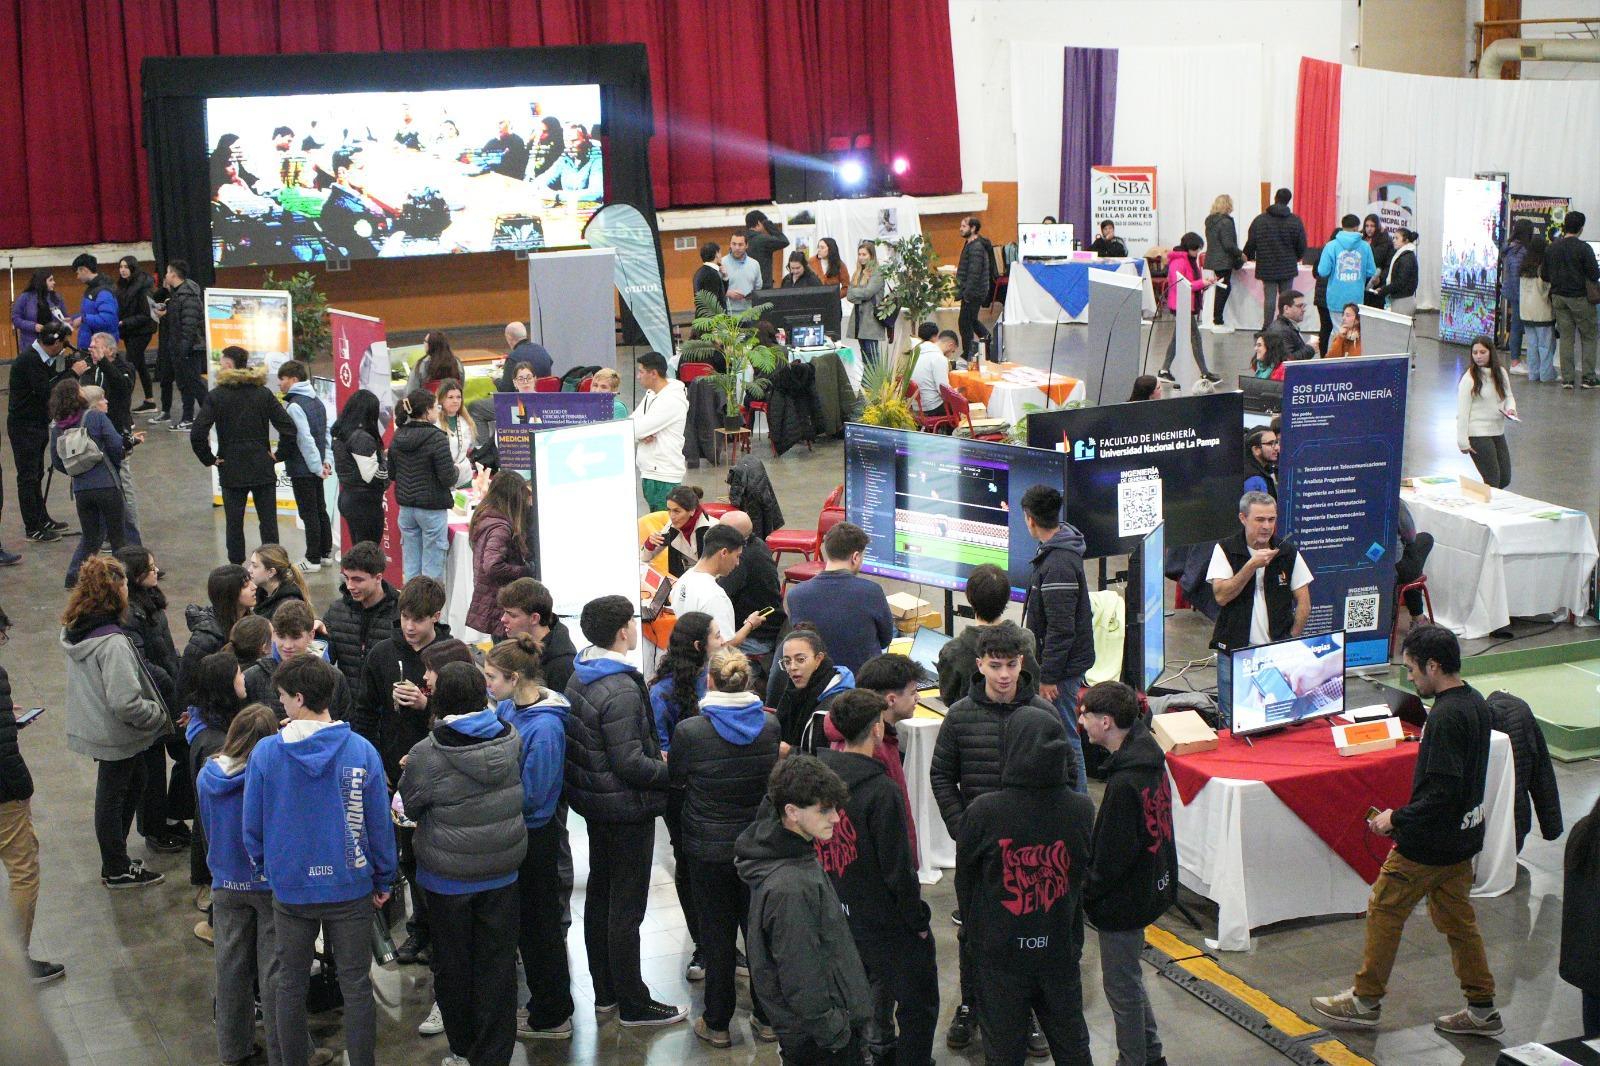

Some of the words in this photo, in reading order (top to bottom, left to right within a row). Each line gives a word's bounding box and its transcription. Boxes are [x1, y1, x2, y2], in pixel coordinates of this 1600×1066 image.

[1113, 182, 1150, 194] ISBA
[1380, 208, 1401, 217] CENTRO
[1292, 385, 1312, 394] SOS
[1314, 382, 1353, 393] FUTURO
[1292, 392, 1335, 405] ESTUDIÁ
[1337, 388, 1393, 402] INGENIERÍA
[499, 435, 530, 443] MEDICIN
[1100, 435, 1138, 448] FACULTAD
[1140, 433, 1150, 443] DE
[1152, 427, 1196, 442] INGENIERÍA
[1100, 446, 1143, 459] Universidad
[1144, 442, 1174, 454] Nacional
[1175, 441, 1185, 450] de
[1186, 439, 1195, 449] La
[1196, 437, 1220, 450] Pampa
[1304, 464, 1331, 473] Tecnicatura
[1324, 475, 1356, 484] Programador
[308, 865, 334, 877] AGUS
[1017, 935, 1049, 950] TOBI
